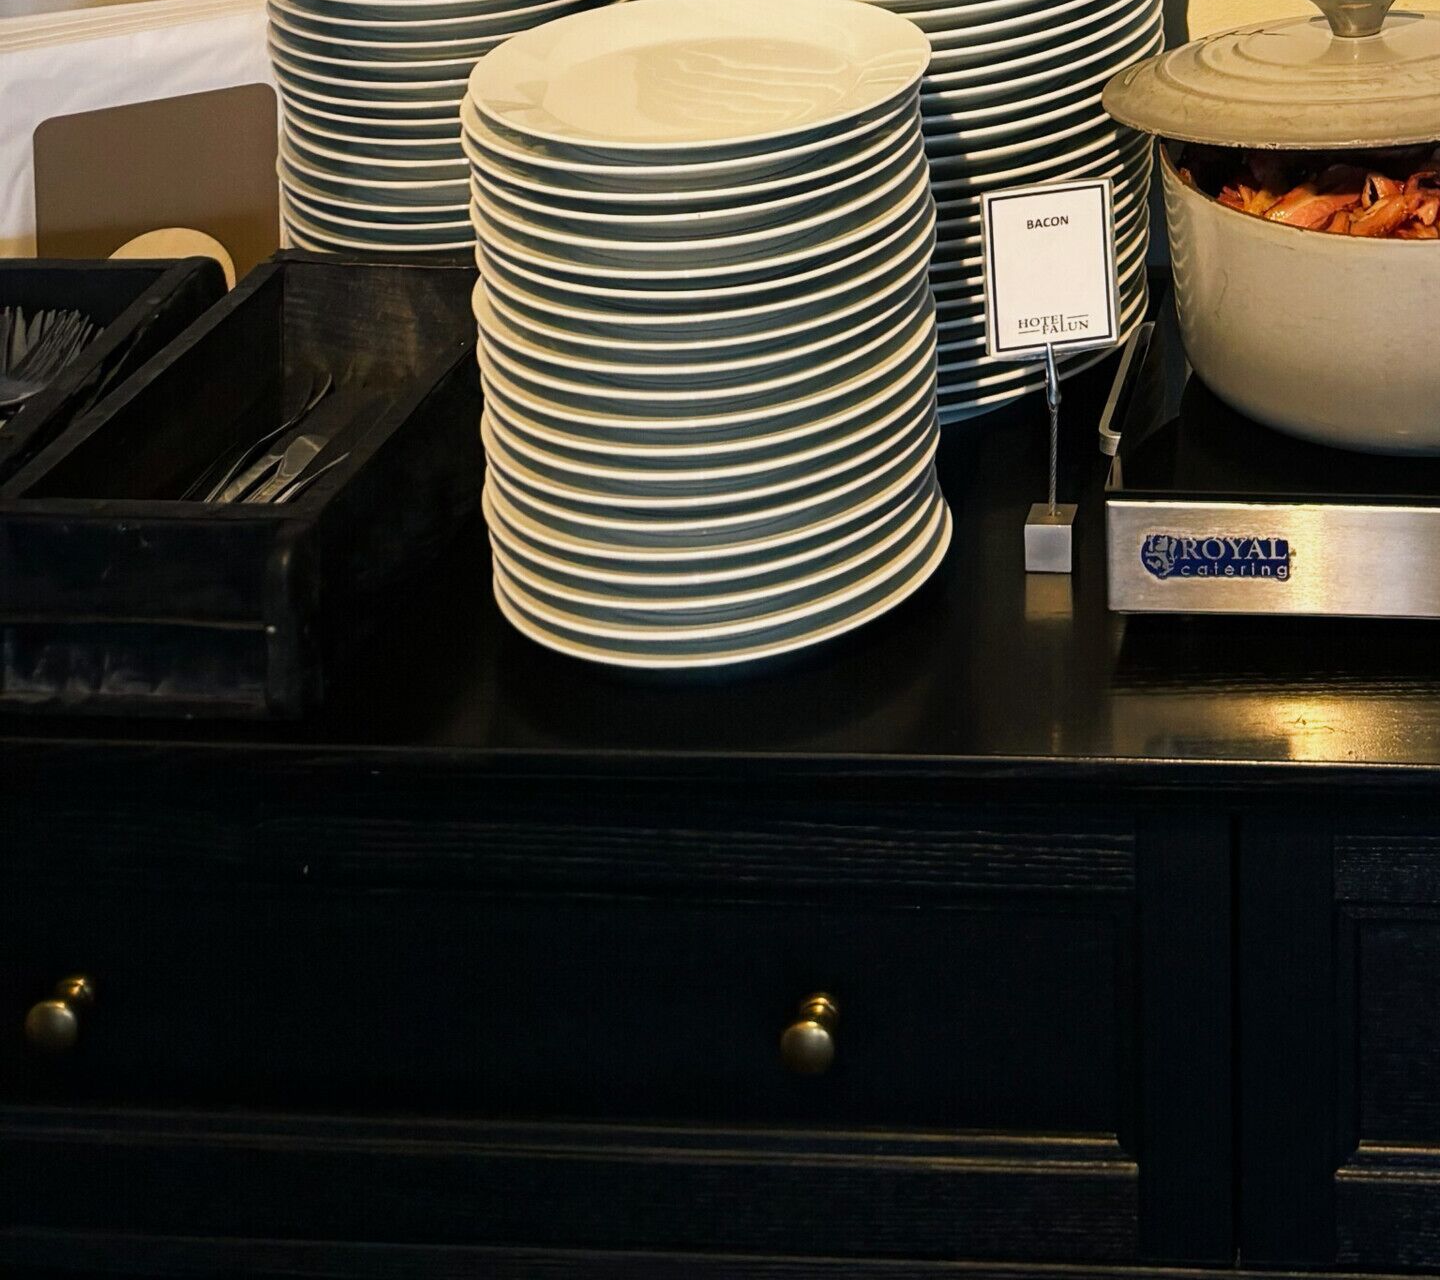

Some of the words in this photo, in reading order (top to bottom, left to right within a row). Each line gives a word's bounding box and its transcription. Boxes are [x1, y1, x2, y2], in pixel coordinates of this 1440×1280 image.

[1026, 215, 1069, 230] BACON
[1018, 314, 1064, 330] HOTEL
[1042, 318, 1089, 335] FALUN
[1180, 537, 1288, 560] ROYAL
[1180, 562, 1289, 579] catering
